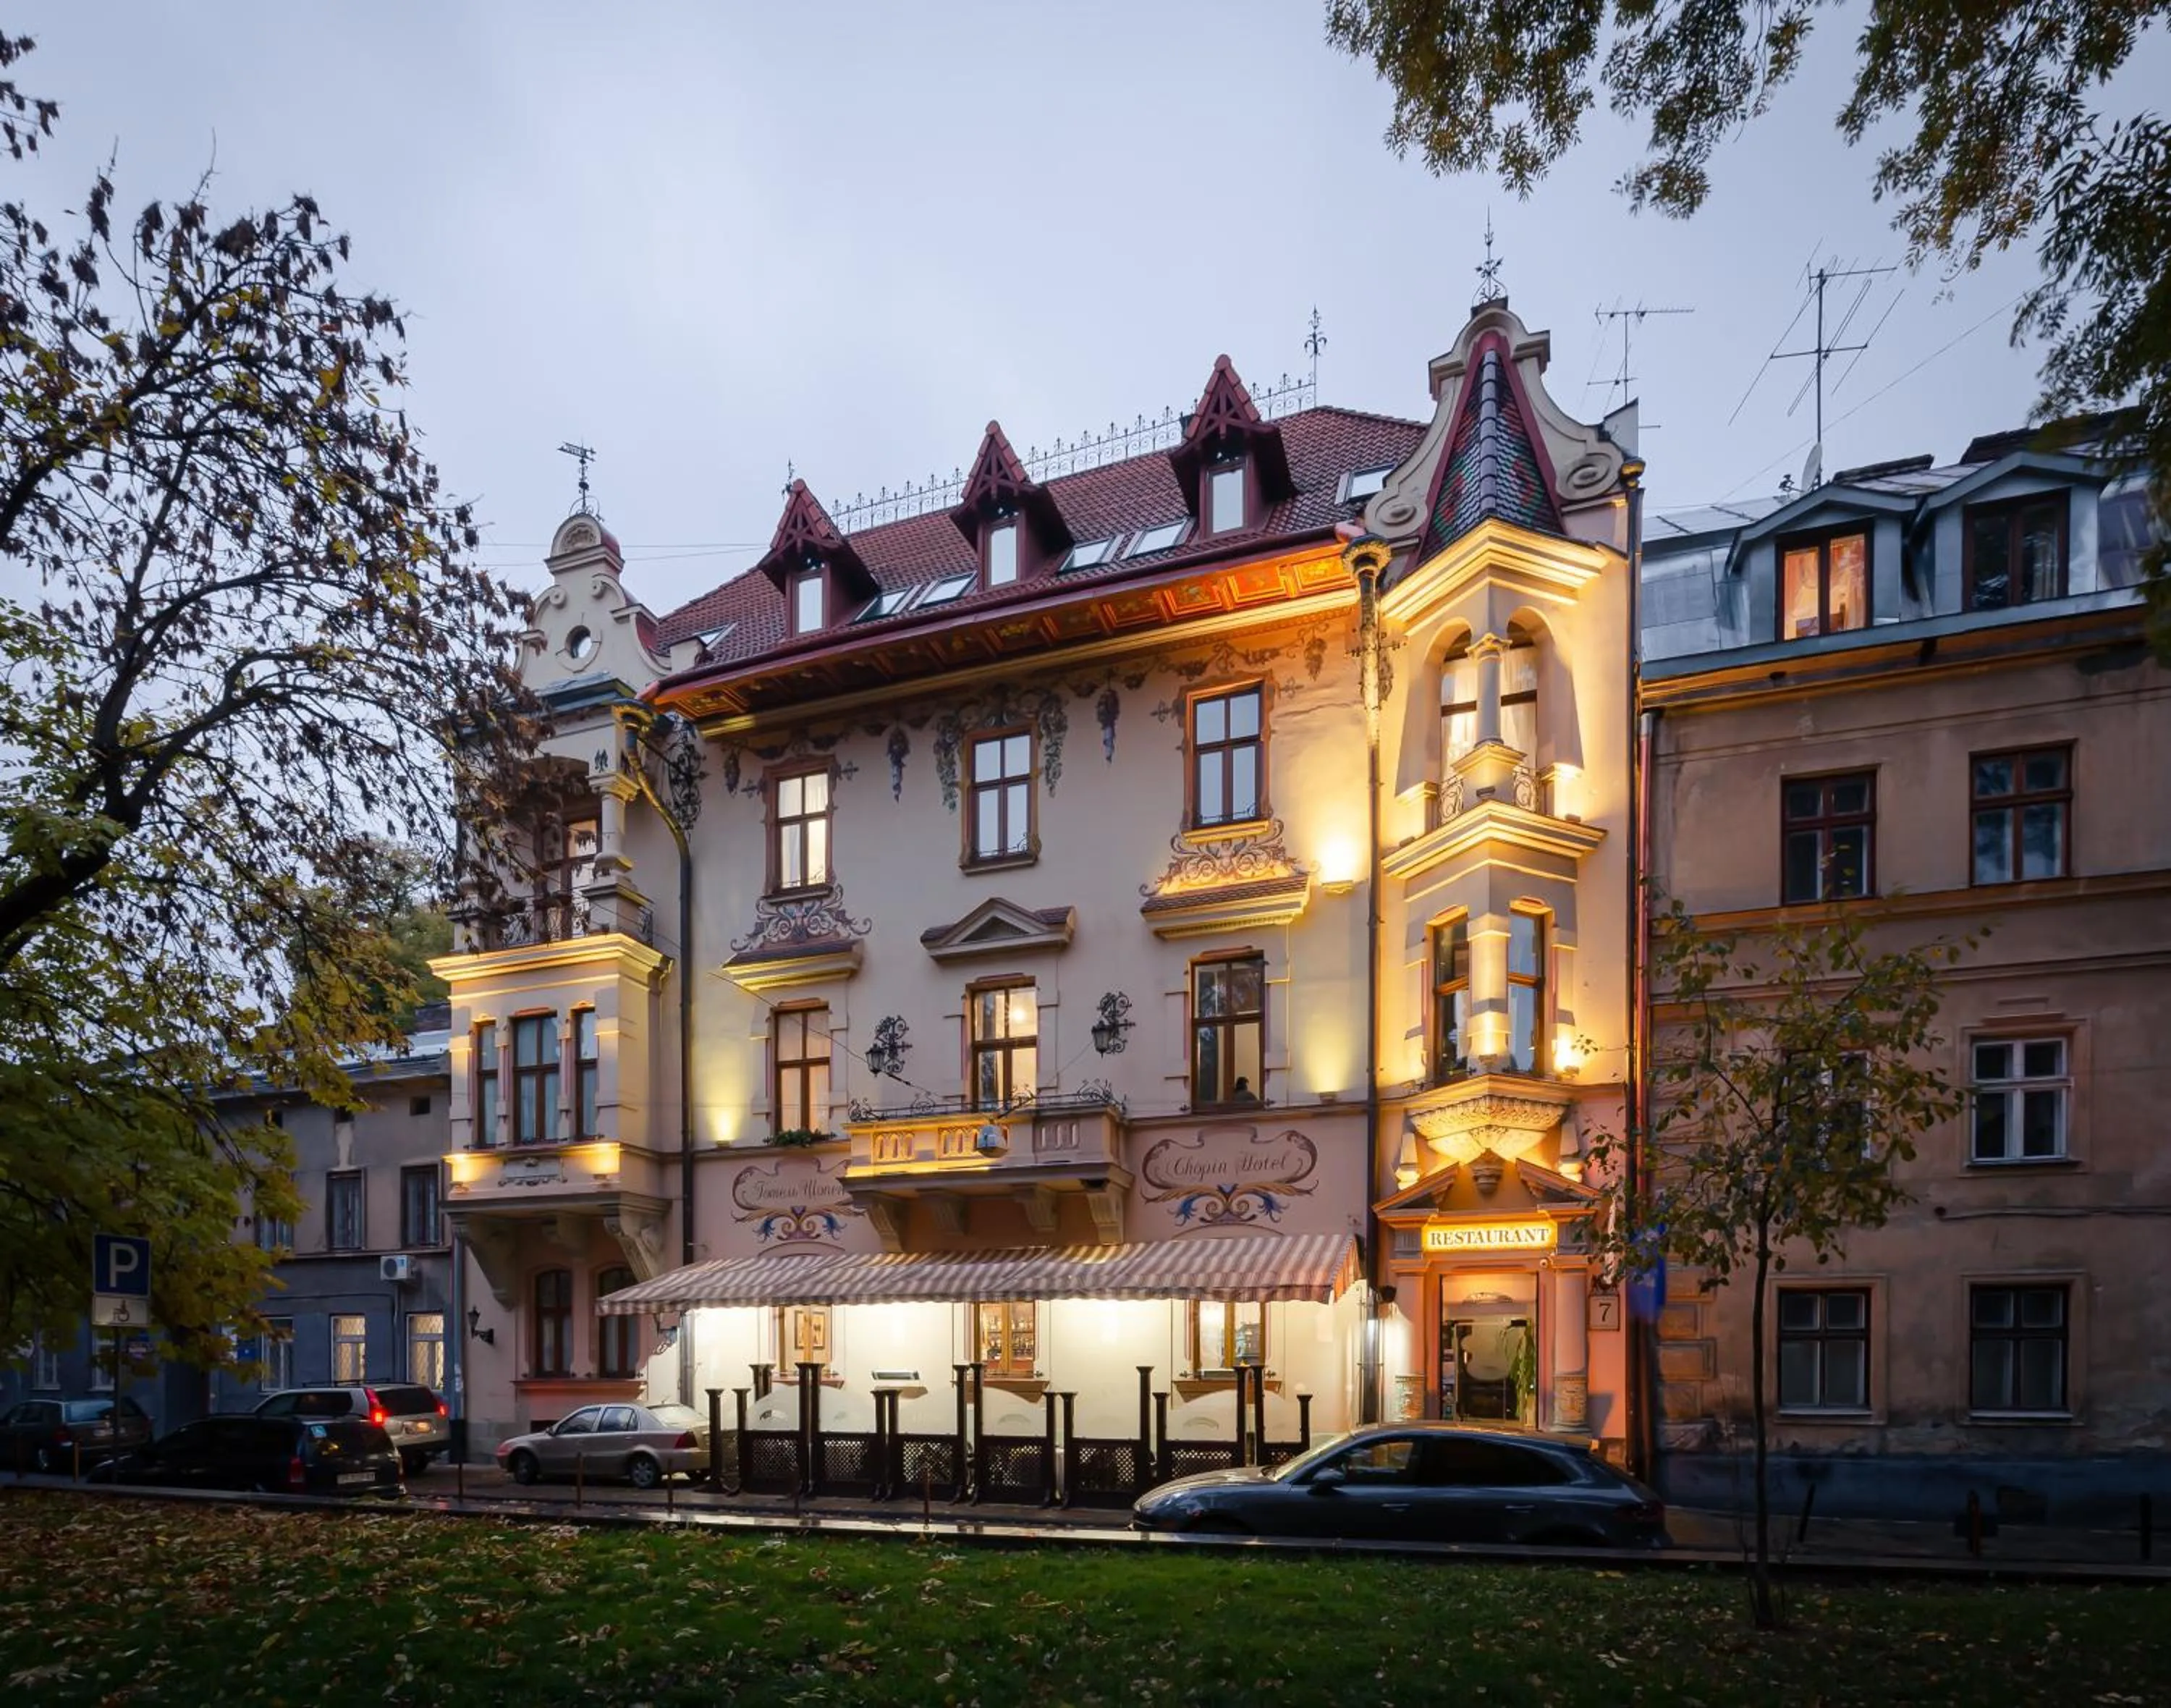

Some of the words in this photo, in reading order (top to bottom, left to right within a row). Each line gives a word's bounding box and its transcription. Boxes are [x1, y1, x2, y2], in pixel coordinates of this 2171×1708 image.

[1172, 1156, 1227, 1180] Chopin
[1237, 1150, 1288, 1174] Hotel
[1429, 1227, 1550, 1246] RESTAURANT
[109, 1241, 139, 1288] P
[1599, 1303, 1612, 1322] 7
